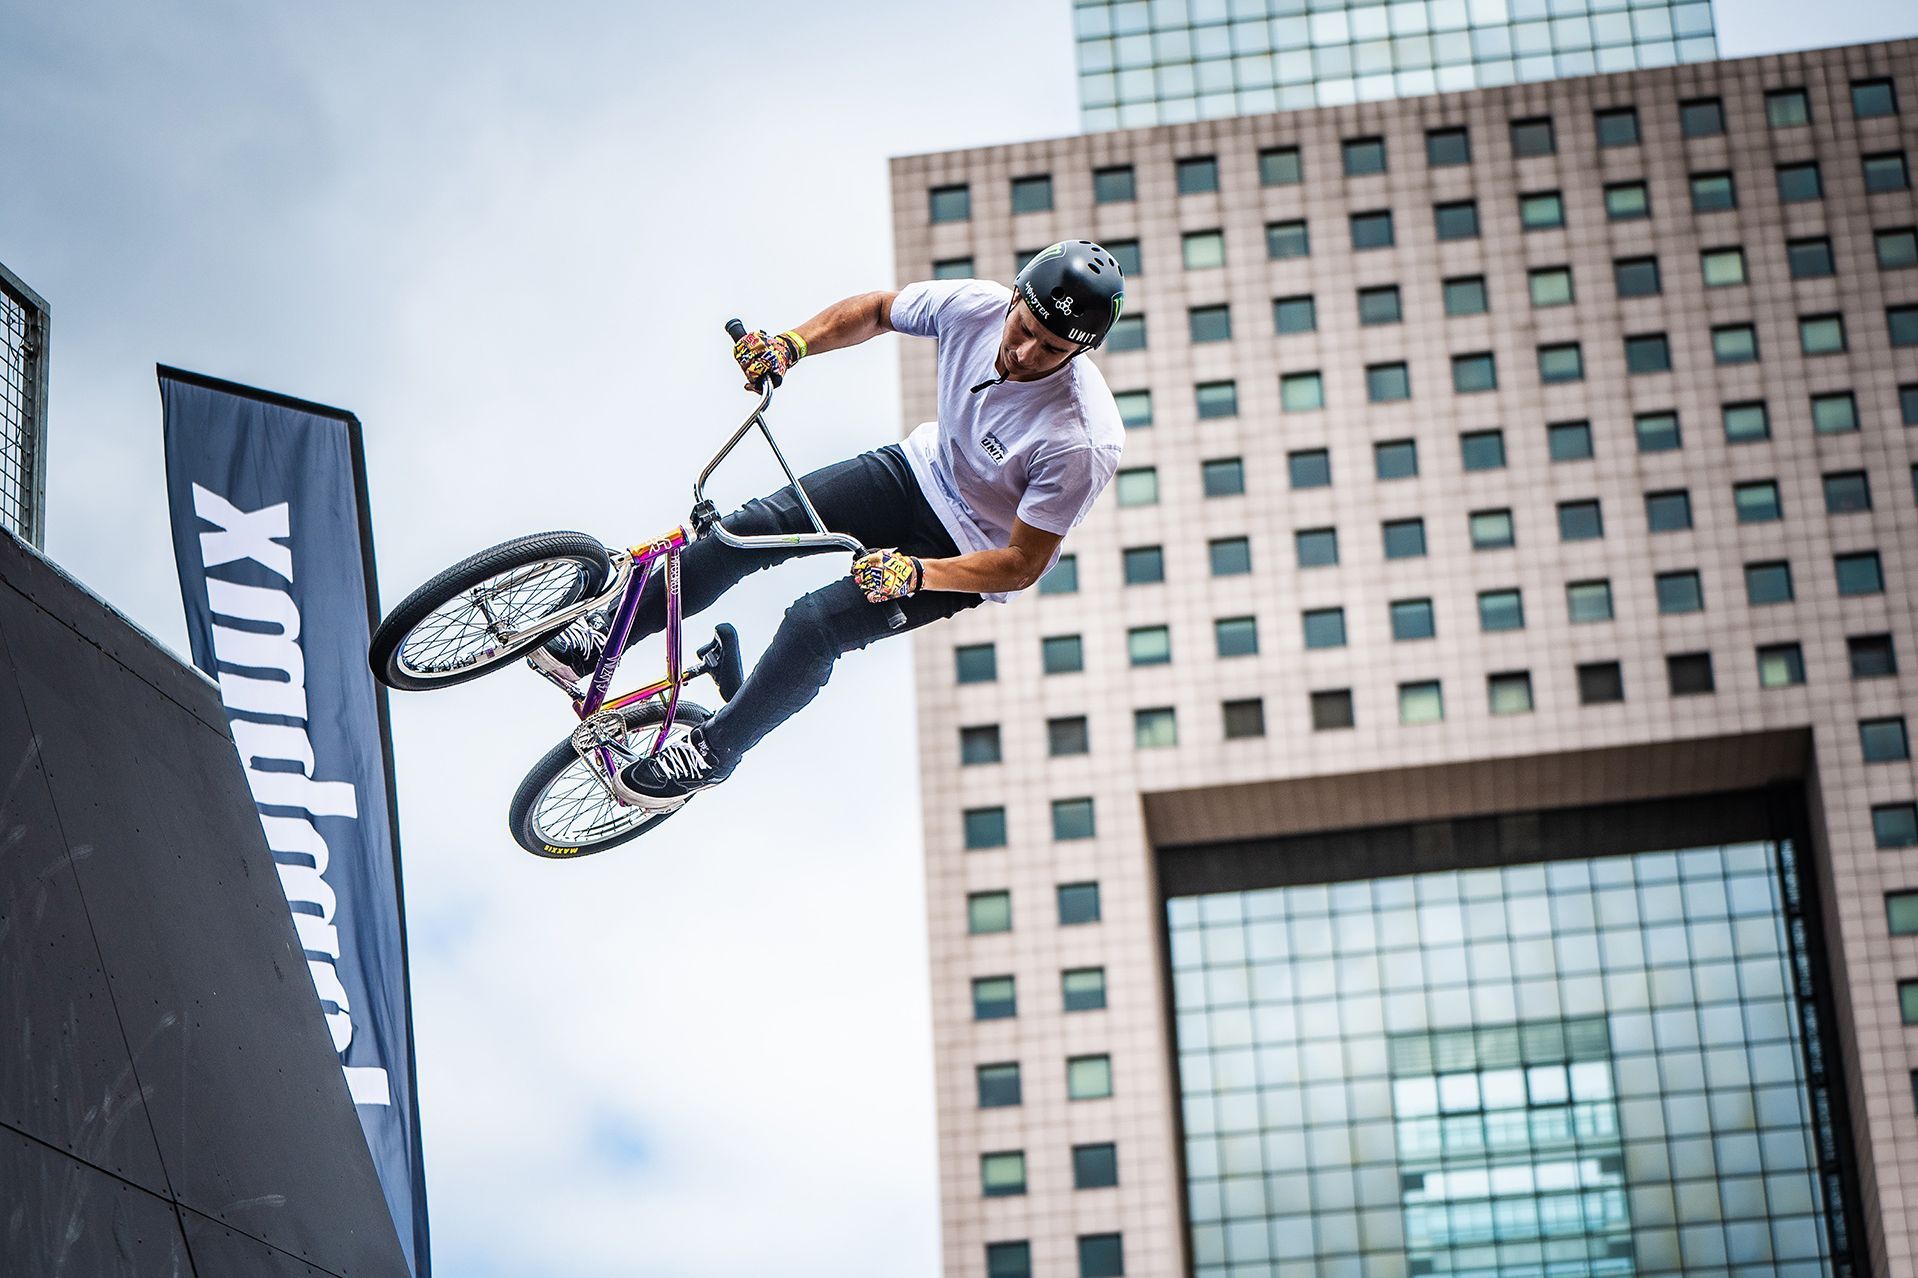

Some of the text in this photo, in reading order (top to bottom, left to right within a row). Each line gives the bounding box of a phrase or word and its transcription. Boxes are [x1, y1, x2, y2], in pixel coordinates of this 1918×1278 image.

[1025, 281, 1050, 319] MONSTER
[1068, 328, 1097, 344] UNIT
[981, 438, 1003, 461] UNIT
[543, 844, 579, 854] MAXXIS
